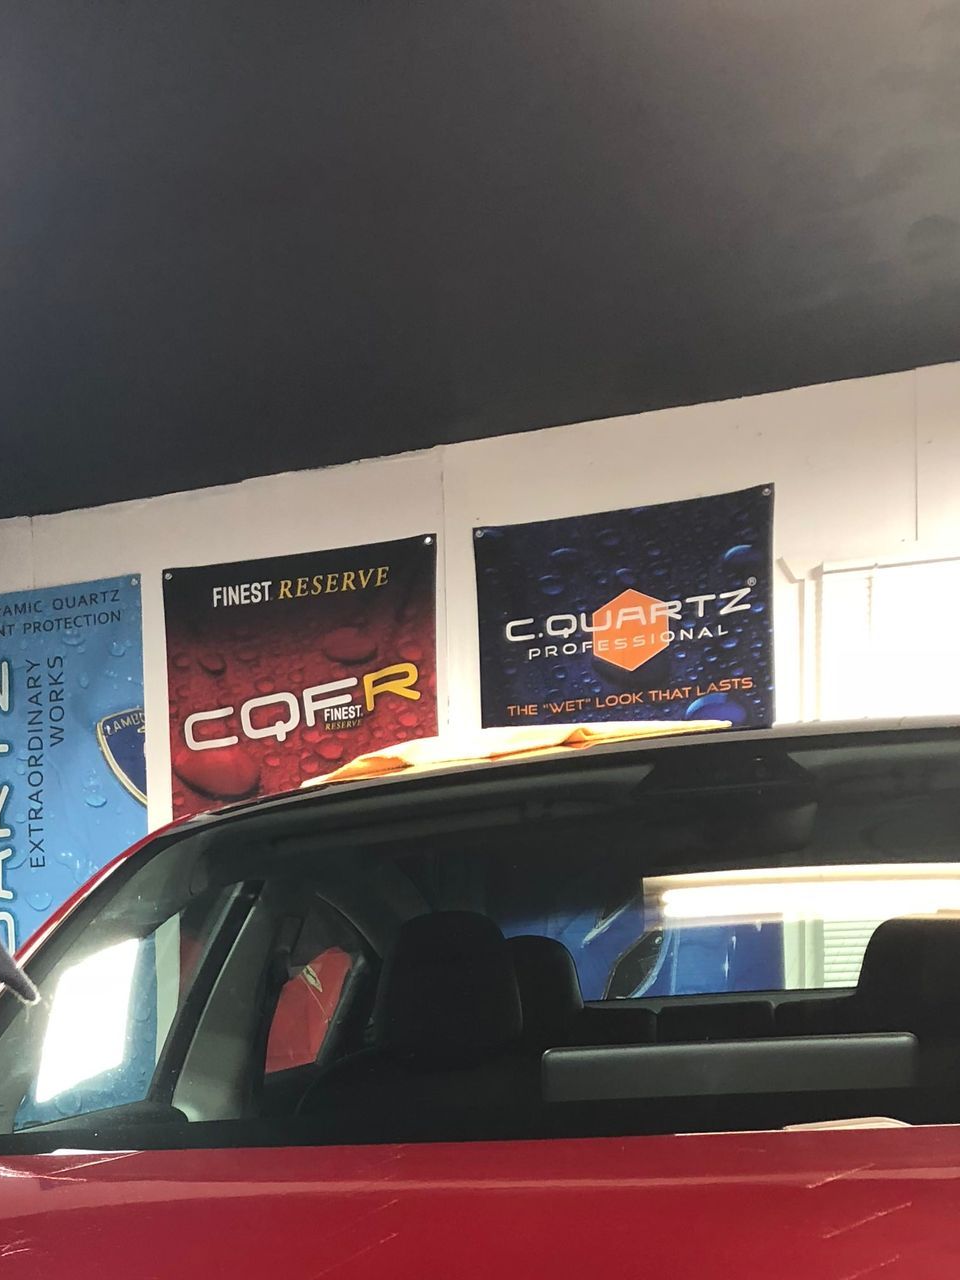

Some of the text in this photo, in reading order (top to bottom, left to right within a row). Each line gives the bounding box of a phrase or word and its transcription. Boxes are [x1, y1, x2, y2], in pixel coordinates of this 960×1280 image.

[52, 589, 121, 611] QUARTZ
[212, 566, 390, 608] FINEST RESERVE
[23, 609, 122, 635] PROTECTION
[528, 624, 729, 660] PROFESSIONAL
[47, 655, 65, 748] WORKS
[184, 662, 421, 751] CQFR
[324, 705, 362, 722] FINEST
[507, 704, 538, 717] THE
[542, 698, 591, 714] "WET"
[596, 691, 644, 708] LOOK
[649, 686, 692, 701] THAT
[26, 658, 46, 868] EXTRAORDINARY
